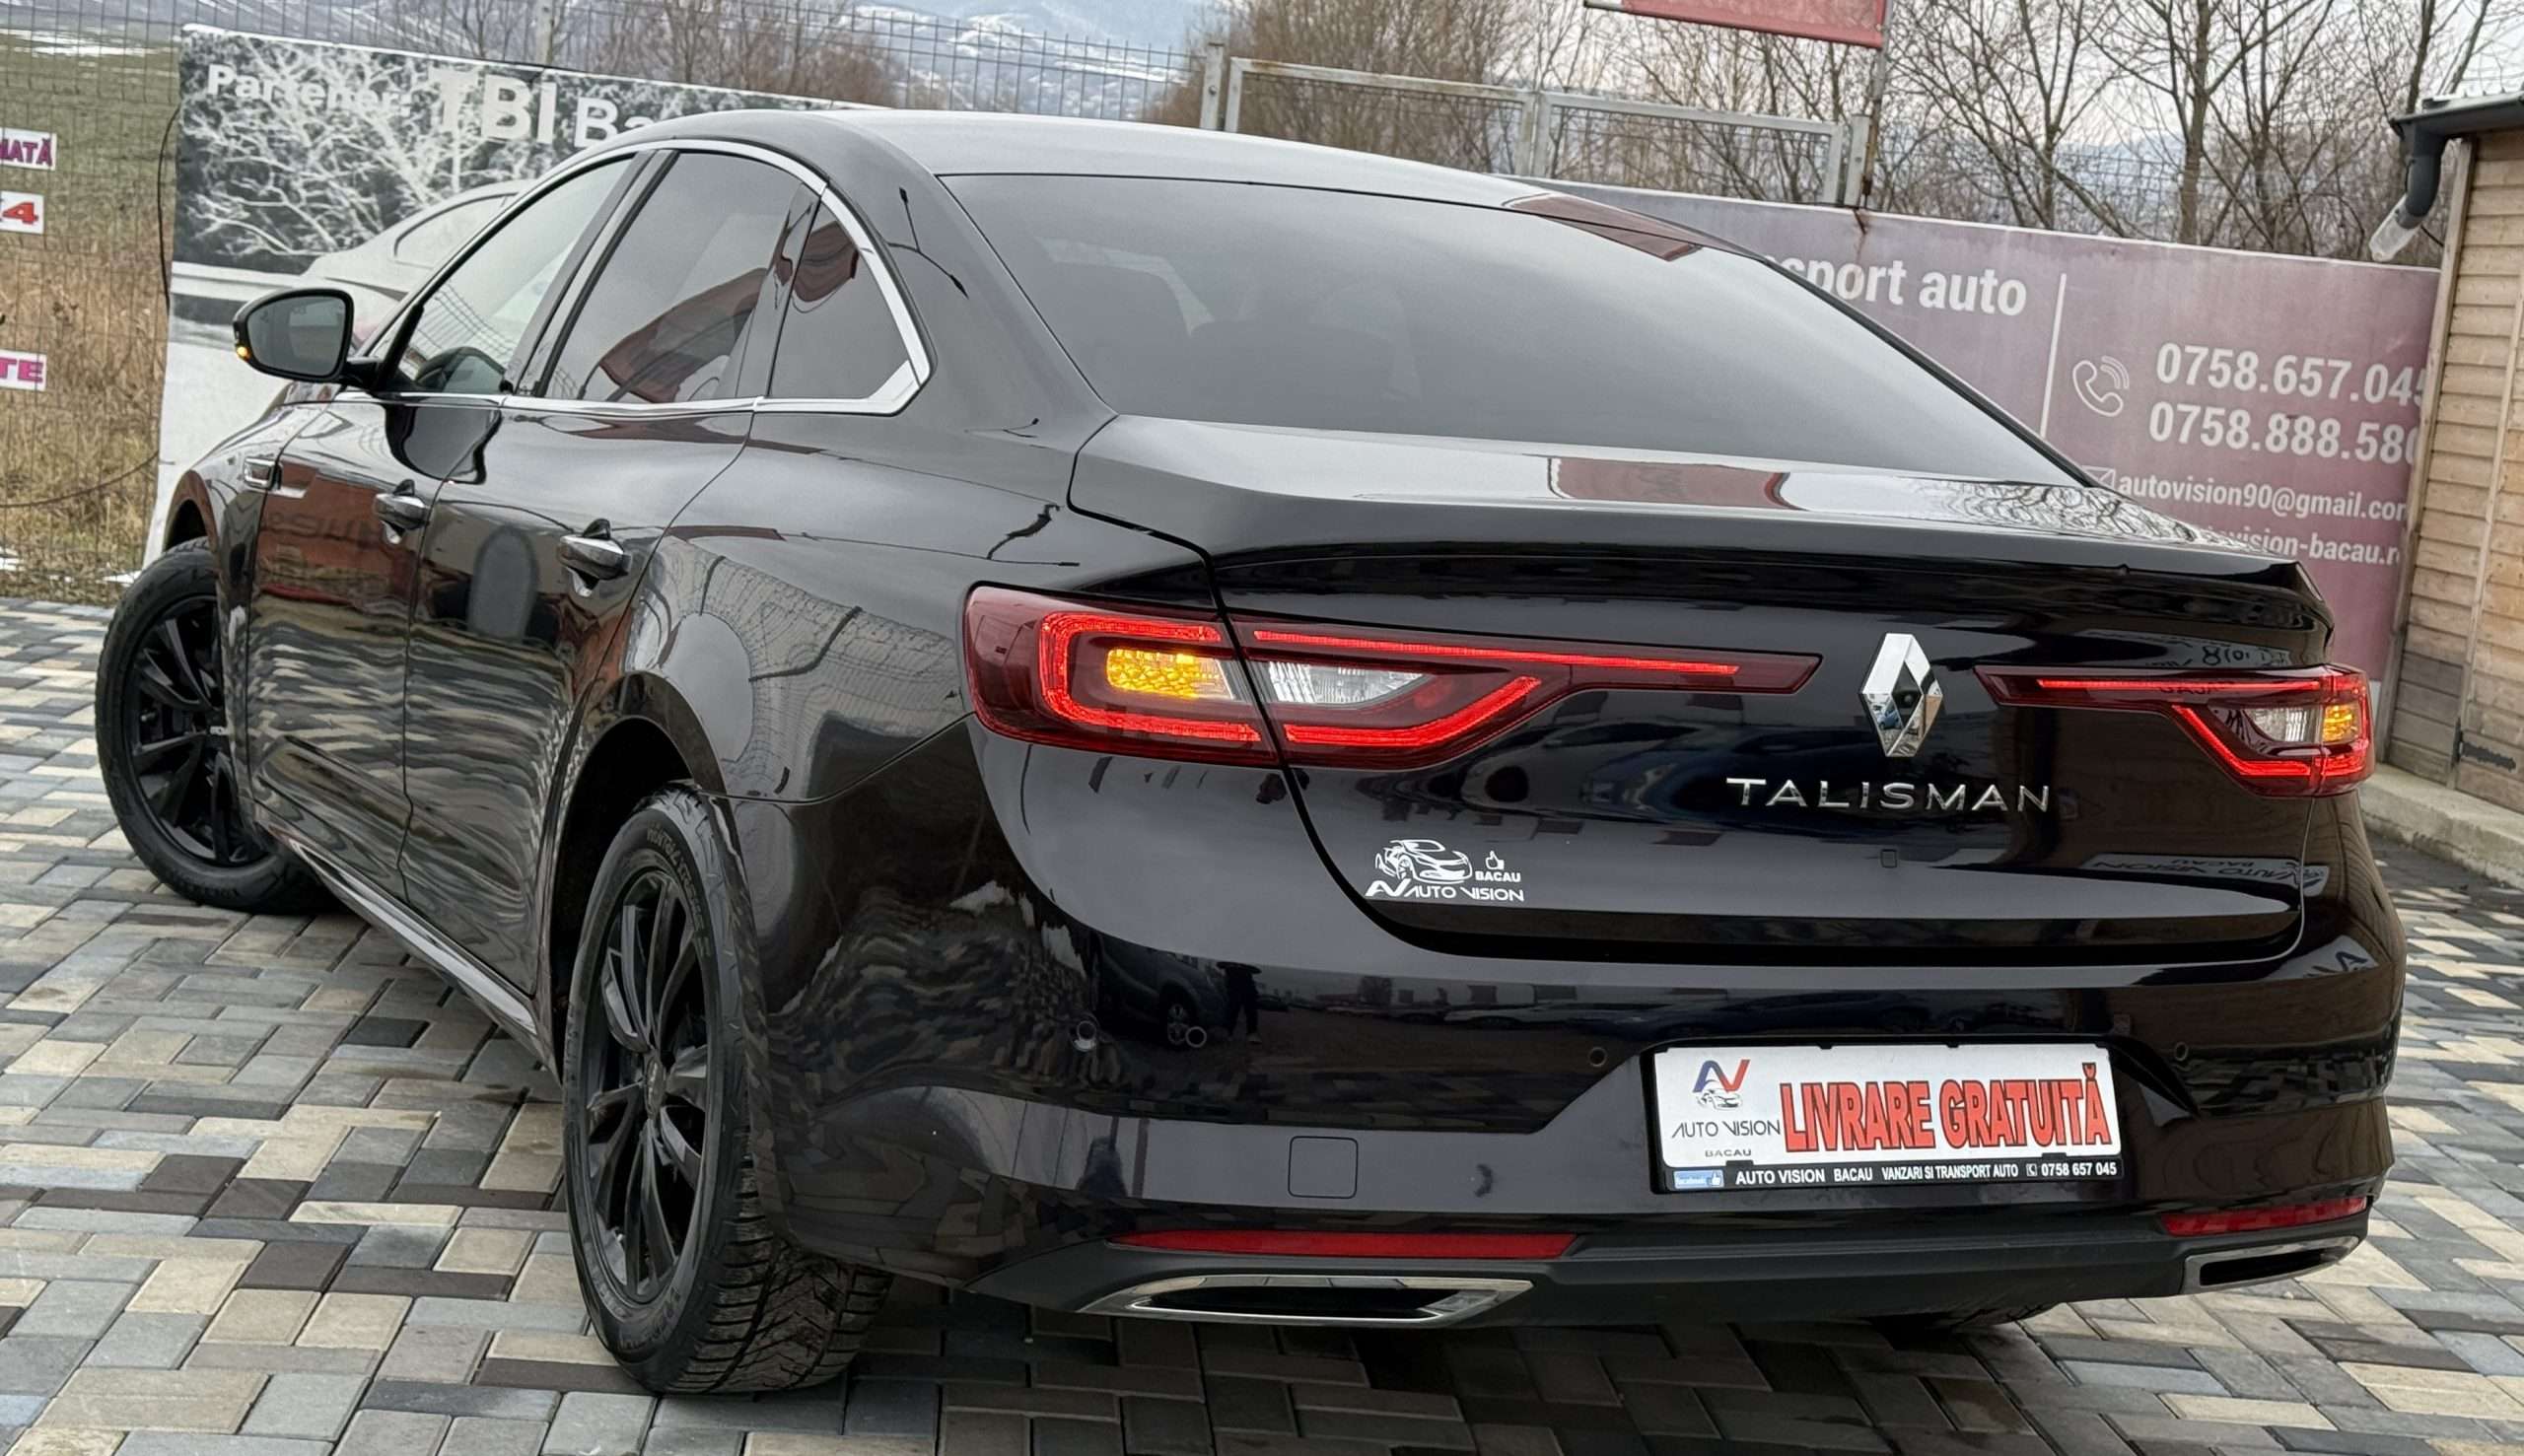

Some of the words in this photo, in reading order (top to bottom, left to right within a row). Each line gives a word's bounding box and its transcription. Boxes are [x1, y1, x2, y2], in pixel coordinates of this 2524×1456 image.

[428, 66, 556, 144] TBI
[0, 201, 38, 225] 4
[1765, 255, 1906, 306] port
[1919, 268, 2027, 316] auto
[1725, 777, 2050, 812] TALISMAN
[1475, 870, 1521, 882] BACAU
[1404, 884, 1456, 899] AUTO
[1460, 886, 1524, 901] VISION
[1780, 1081, 1936, 1152] LIVRARE
[1939, 1062, 2112, 1148] GRATUITĂ
[1671, 1121, 1718, 1139] AUTO
[1721, 1119, 1781, 1137] VISION
[1705, 1148, 1752, 1158] BACAU
[1735, 1170, 1775, 1185] AUTO
[1778, 1169, 1825, 1184] VISION
[1833, 1167, 1873, 1182] BACAU
[1881, 1165, 1923, 1180] VANZARI
[1924, 1166, 1934, 1179] SI
[1935, 1164, 1992, 1180] TRANSPORT
[1993, 1163, 2019, 1177] AUTO
[2041, 1162, 2070, 1176] 0758
[2071, 1162, 2093, 1176] 657
[2095, 1161, 2117, 1175] 045
